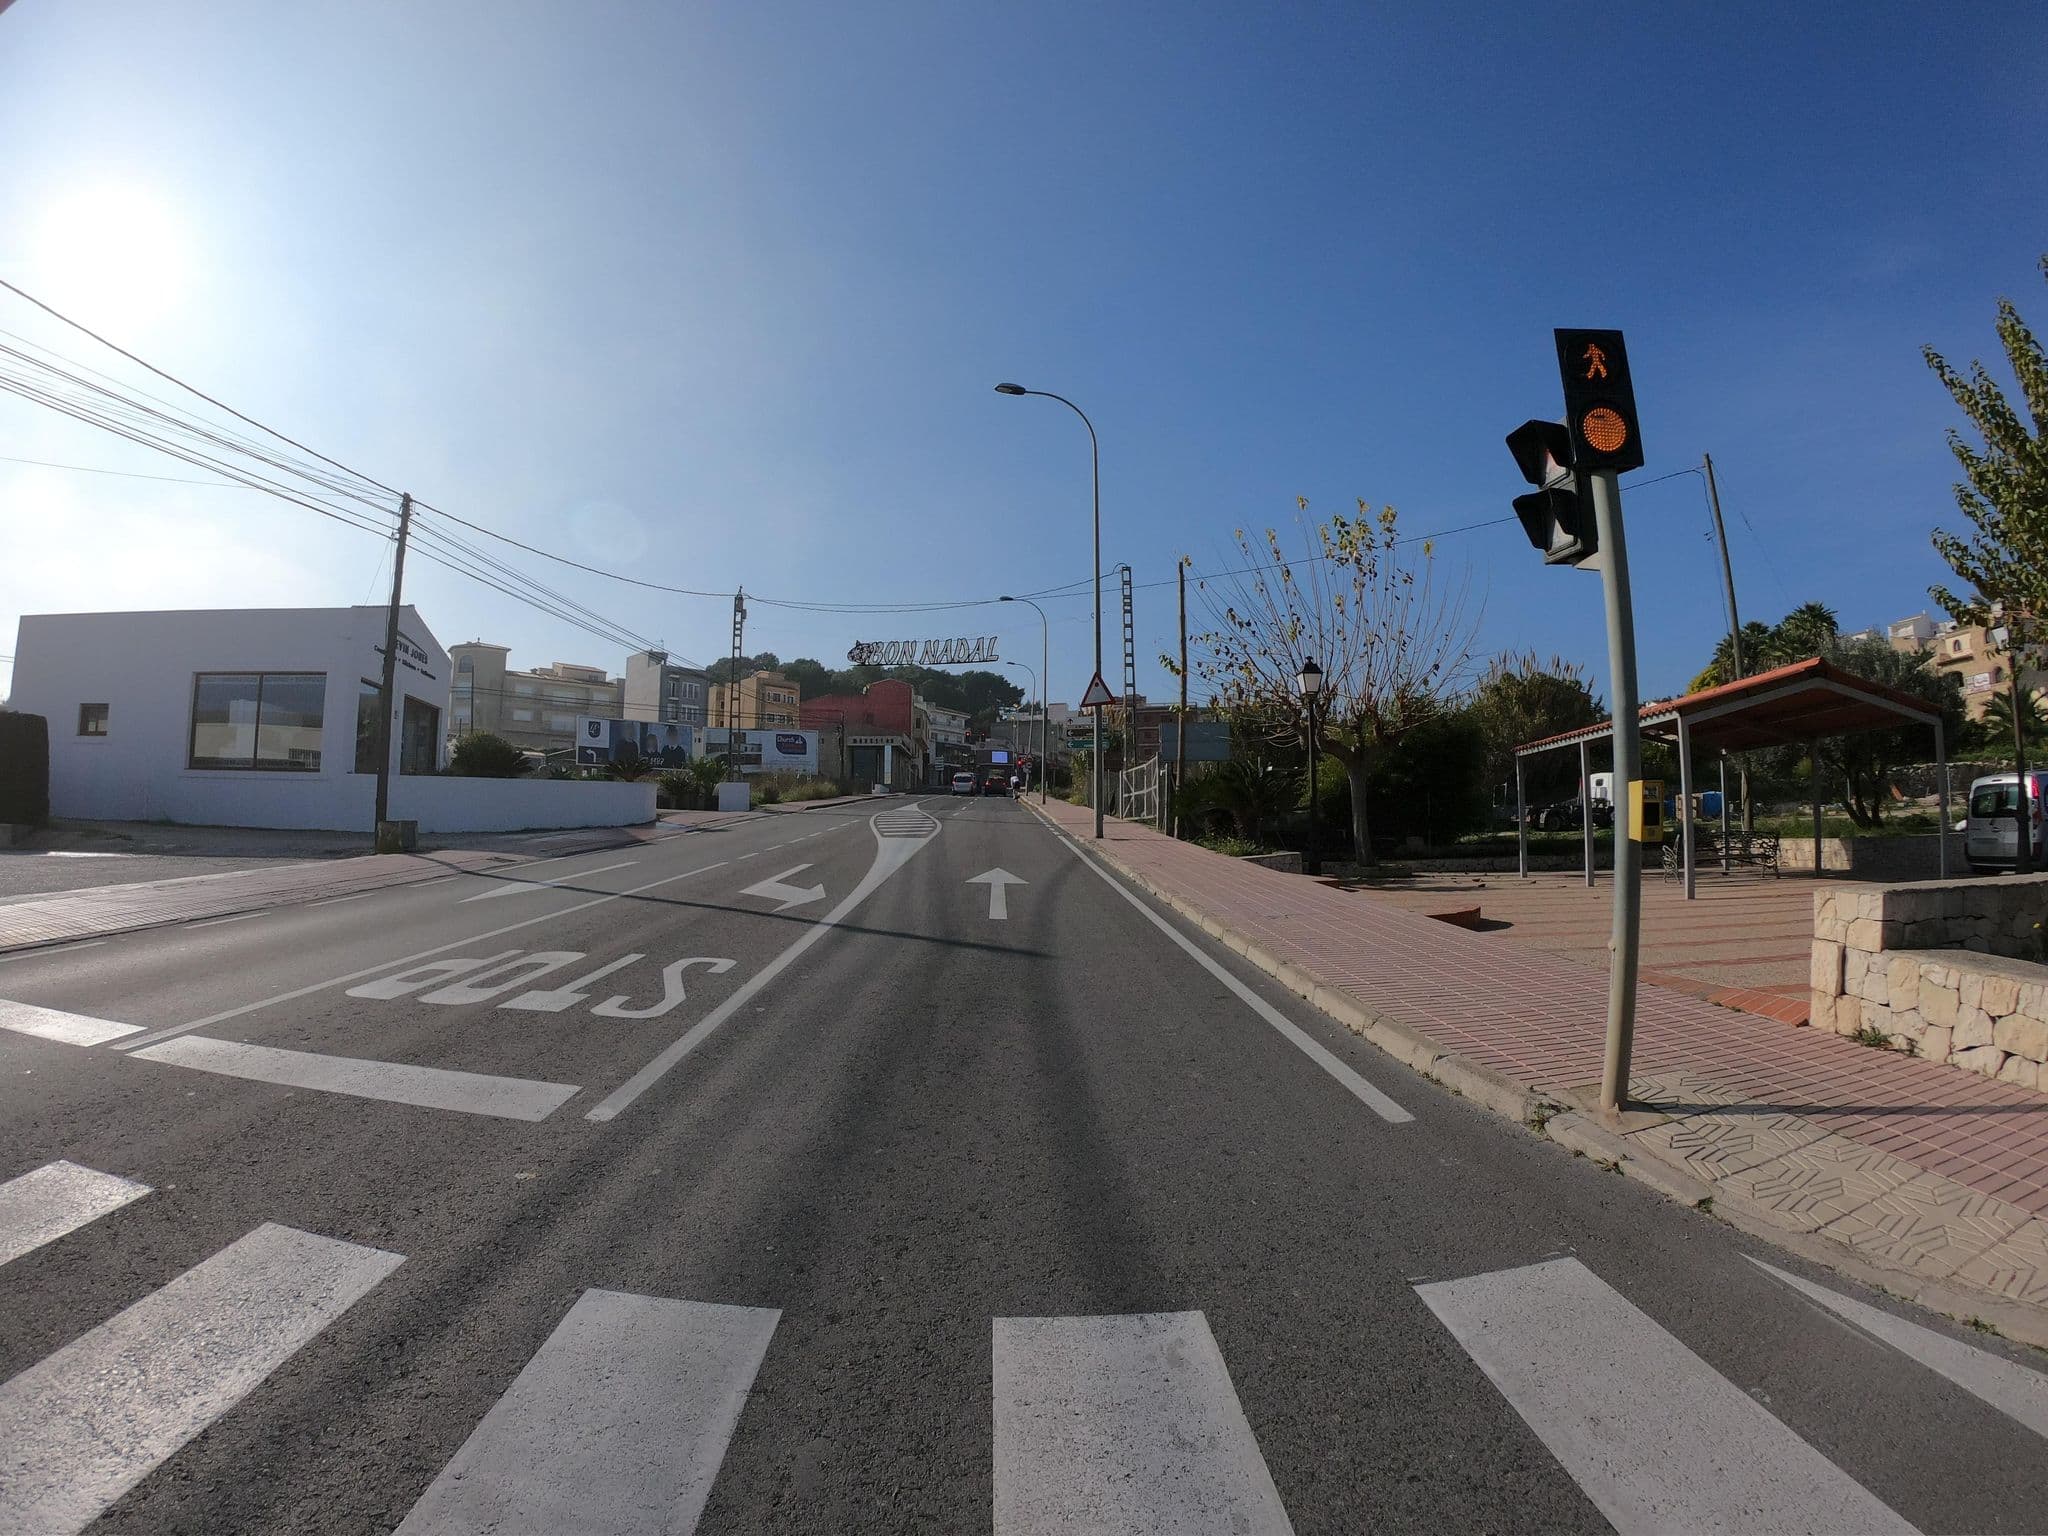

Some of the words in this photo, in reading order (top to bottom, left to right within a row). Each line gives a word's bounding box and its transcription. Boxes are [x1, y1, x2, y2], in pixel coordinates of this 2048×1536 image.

[869, 640, 917, 665] BON
[919, 636, 999, 665] NADAL
[345, 949, 738, 1019] STOP
